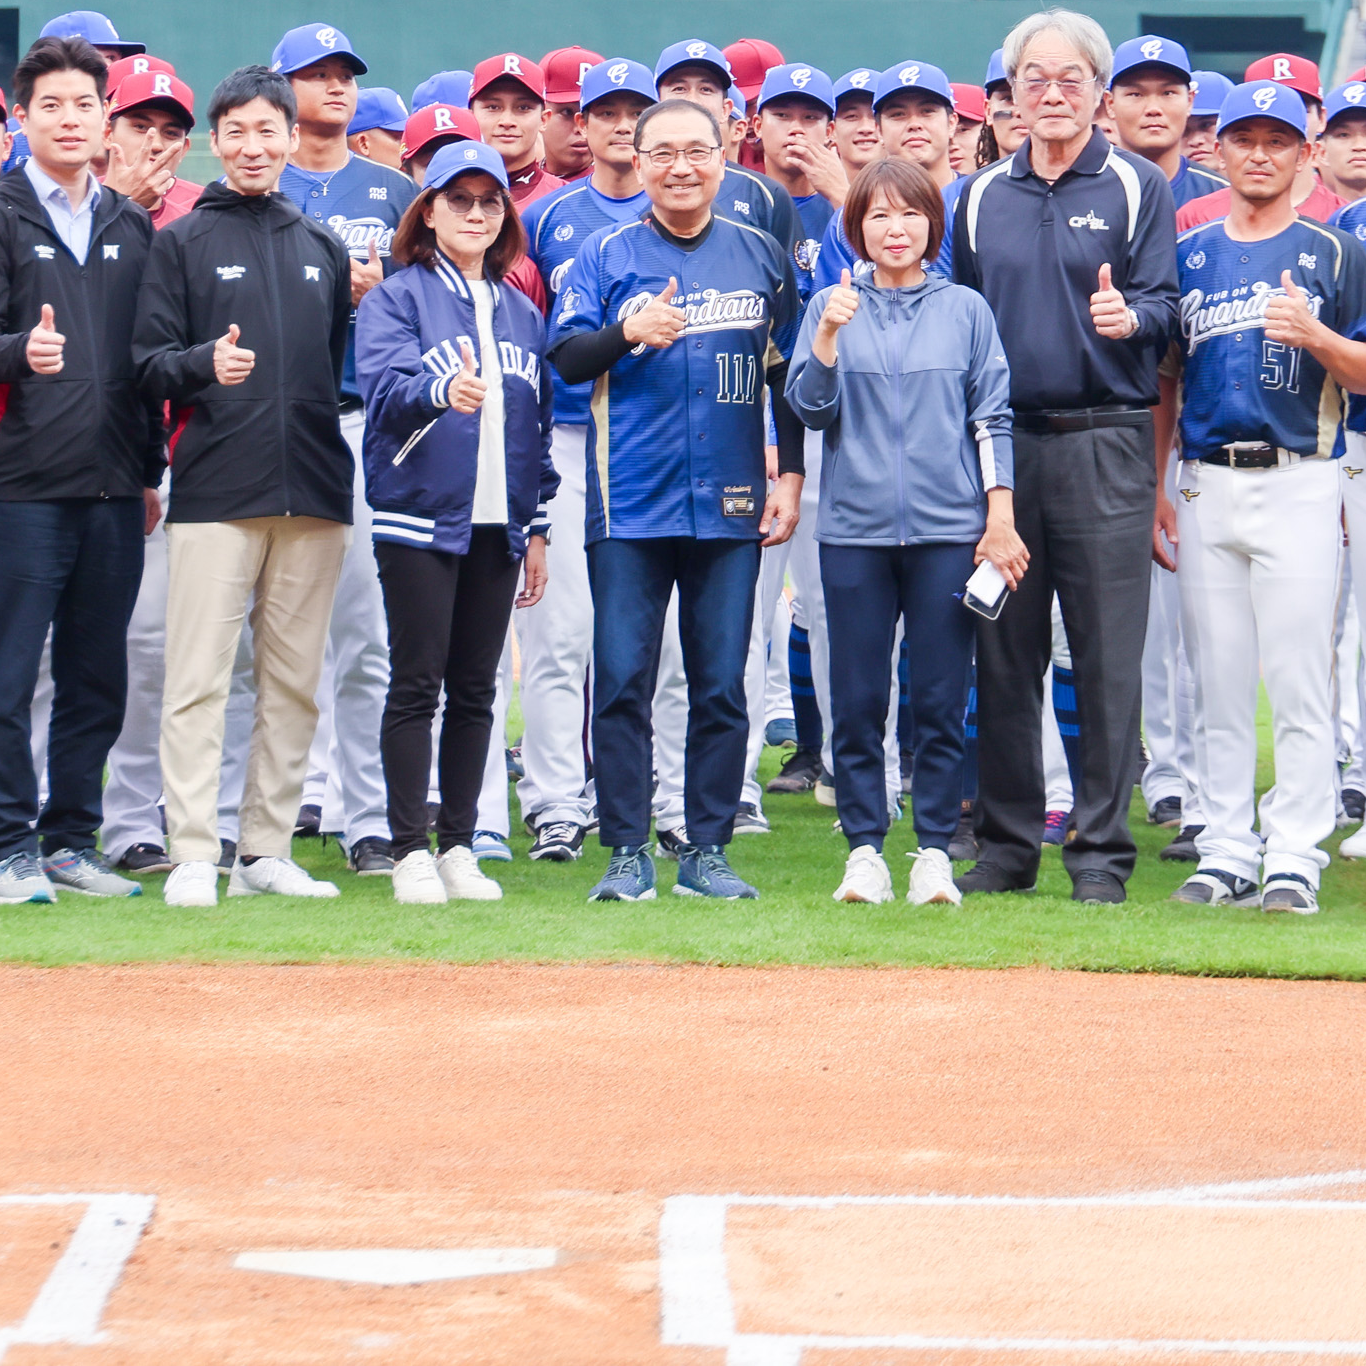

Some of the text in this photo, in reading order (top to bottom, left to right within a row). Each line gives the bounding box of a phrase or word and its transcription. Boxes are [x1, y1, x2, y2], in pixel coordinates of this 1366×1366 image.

[501, 55, 524, 76] R
[1271, 58, 1296, 81] R
[152, 74, 175, 96] R
[434, 107, 458, 131] R
[1069, 210, 1110, 231] CPBL
[715, 352, 756, 405] 111
[1260, 340, 1303, 394] 51
